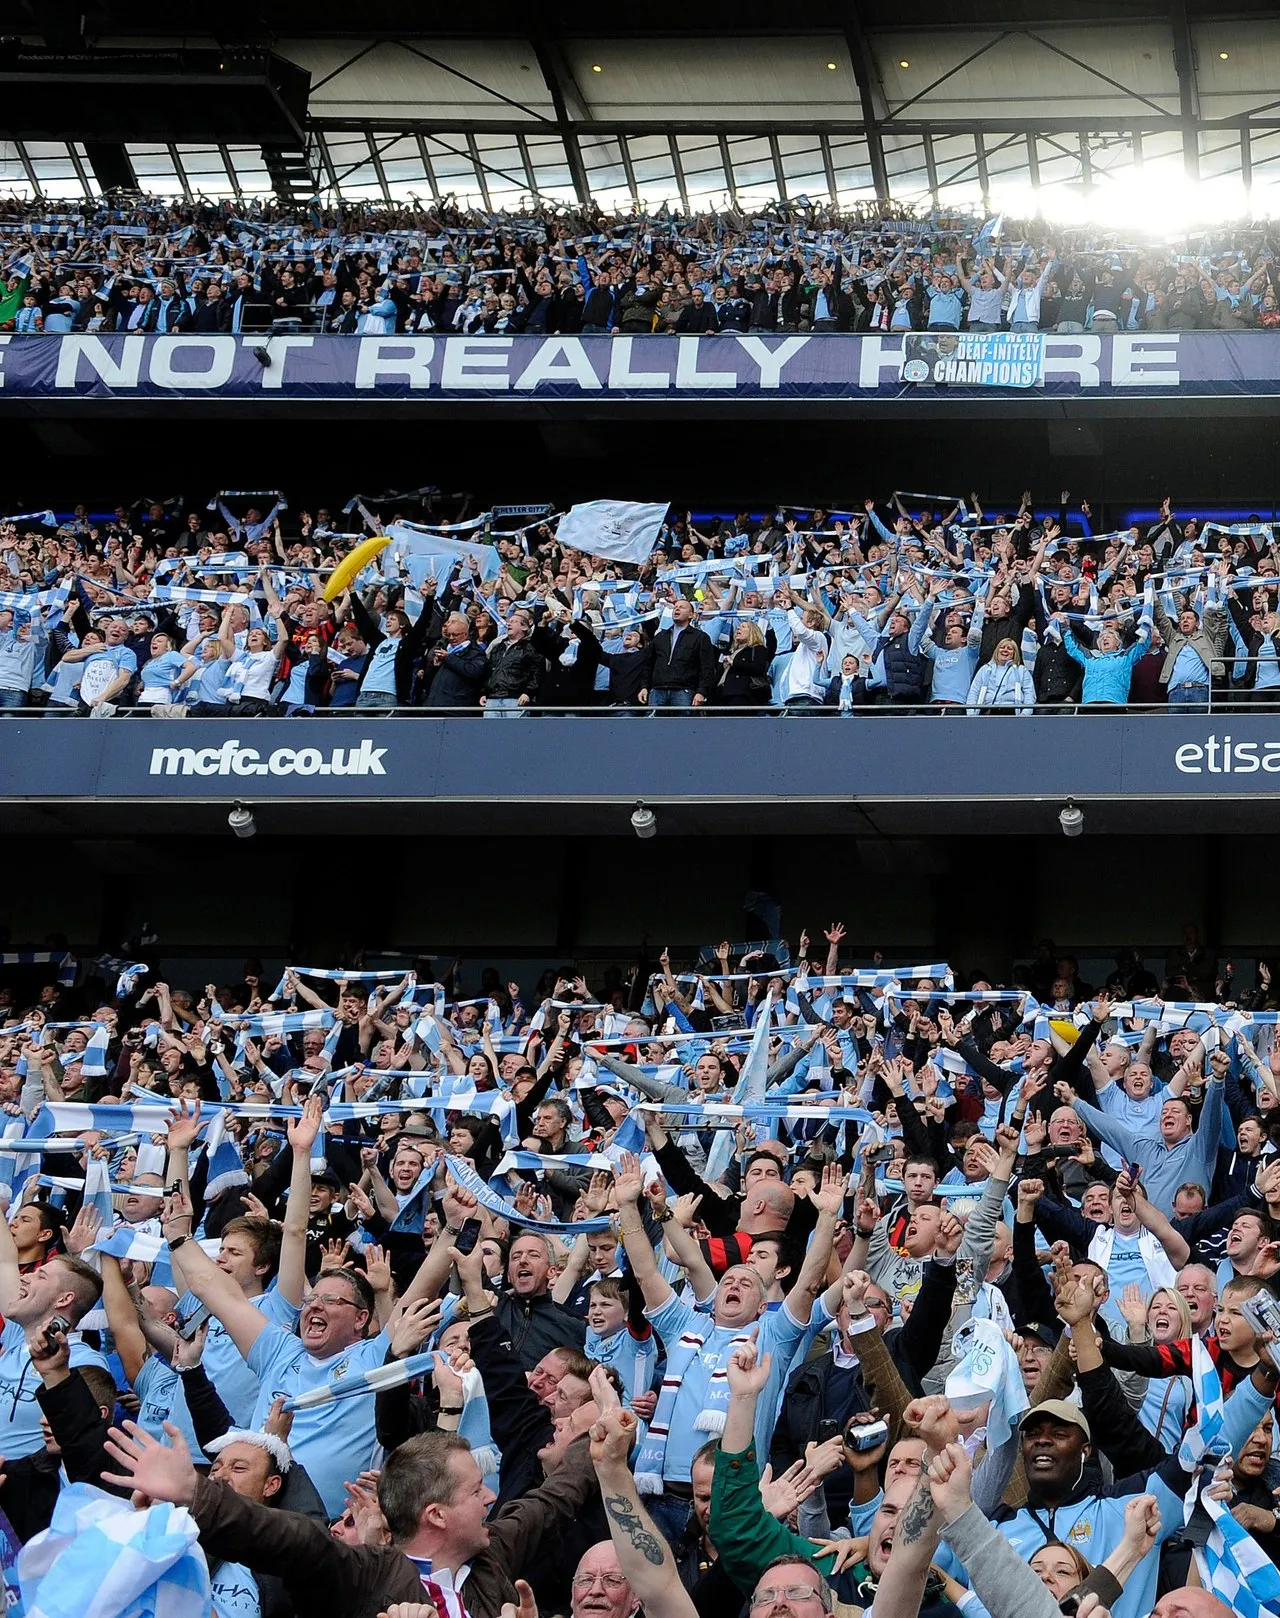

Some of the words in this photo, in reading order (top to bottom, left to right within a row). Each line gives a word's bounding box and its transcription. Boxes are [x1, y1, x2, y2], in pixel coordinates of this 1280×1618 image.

[55, 335, 314, 388] NOT
[355, 335, 811, 389] REALLY
[957, 342, 1040, 361] DEAF-INITELY
[933, 359, 1038, 384] CHAMPIONS!
[149, 739, 389, 776] mcfc.co.uk
